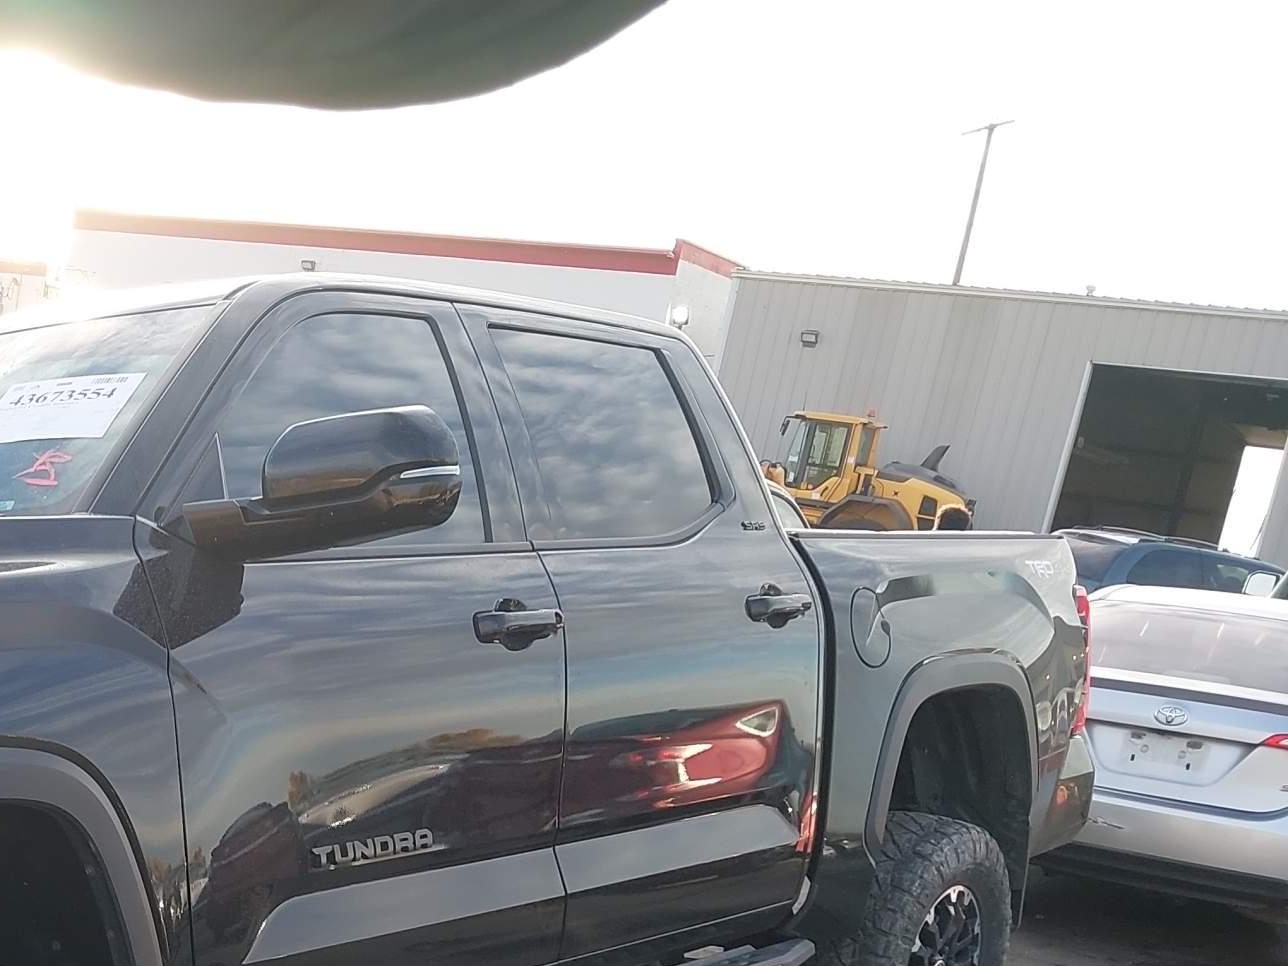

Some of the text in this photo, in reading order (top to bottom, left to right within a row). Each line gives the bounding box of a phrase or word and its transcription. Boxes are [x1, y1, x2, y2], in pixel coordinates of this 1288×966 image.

[8, 386, 118, 407] 43673554
[1024, 560, 1054, 578] TRD
[311, 828, 434, 867] TUNDRA
